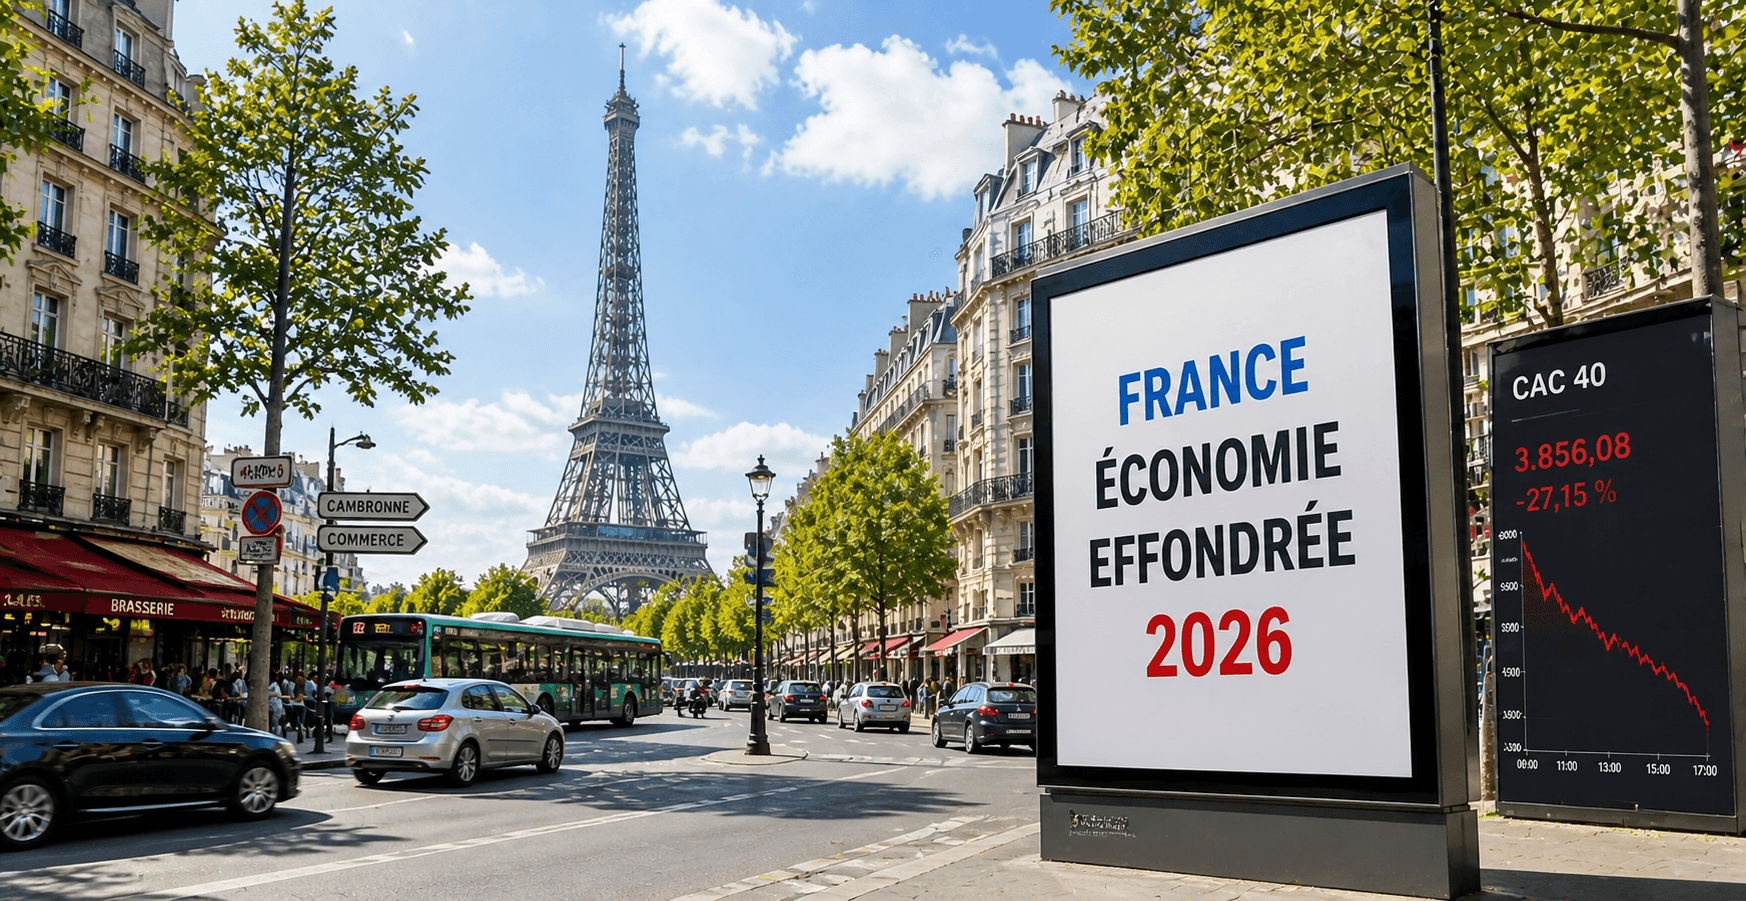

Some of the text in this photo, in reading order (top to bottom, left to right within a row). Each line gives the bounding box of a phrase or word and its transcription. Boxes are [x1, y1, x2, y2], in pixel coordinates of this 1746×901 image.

[1118, 335, 1309, 426] FRANCE
[1512, 361, 1607, 400] CAC 40
[1095, 420, 1342, 510] ÉCONOMIE
[1514, 431, 1631, 473] 3.856,08
[326, 499, 410, 514] CAMBRONNE
[1516, 478, 1618, 514] -27,15 %
[327, 532, 404, 547] COMMERCE
[1089, 499, 1356, 589] EFFONDRÉE
[111, 598, 175, 616] BRASSERIE
[1145, 606, 1293, 678] 2026
[1556, 760, 1578, 772] 11:00
[1598, 762, 1622, 773] 13:00
[1646, 763, 1671, 775] 15:00
[1692, 764, 1718, 776] 17:00
